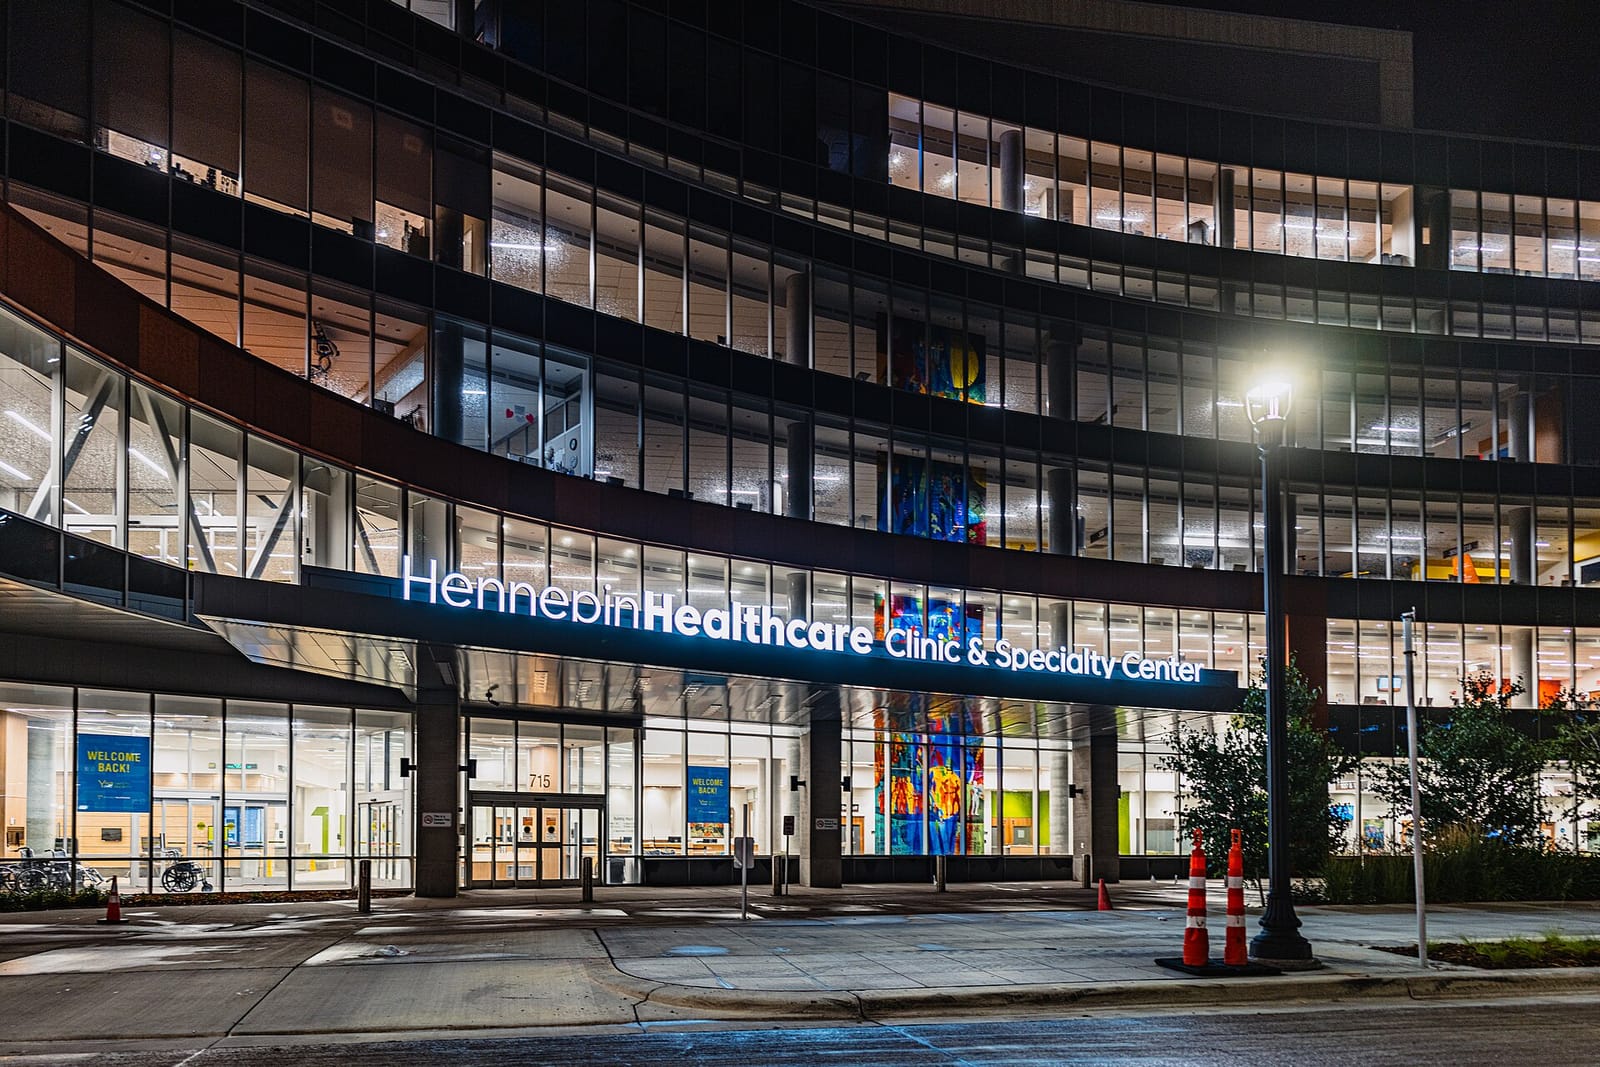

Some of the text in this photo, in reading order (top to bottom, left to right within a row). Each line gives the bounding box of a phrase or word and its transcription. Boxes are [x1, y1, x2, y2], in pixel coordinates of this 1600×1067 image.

[885, 628, 961, 663] Clinic
[966, 636, 990, 666] &
[995, 639, 1116, 680] Specialty
[1121, 651, 1205, 683] Center
[87, 751, 141, 762] WELCOME
[98, 762, 130, 773] BACK!
[529, 773, 551, 788] 715
[692, 778, 724, 787] WELCOME
